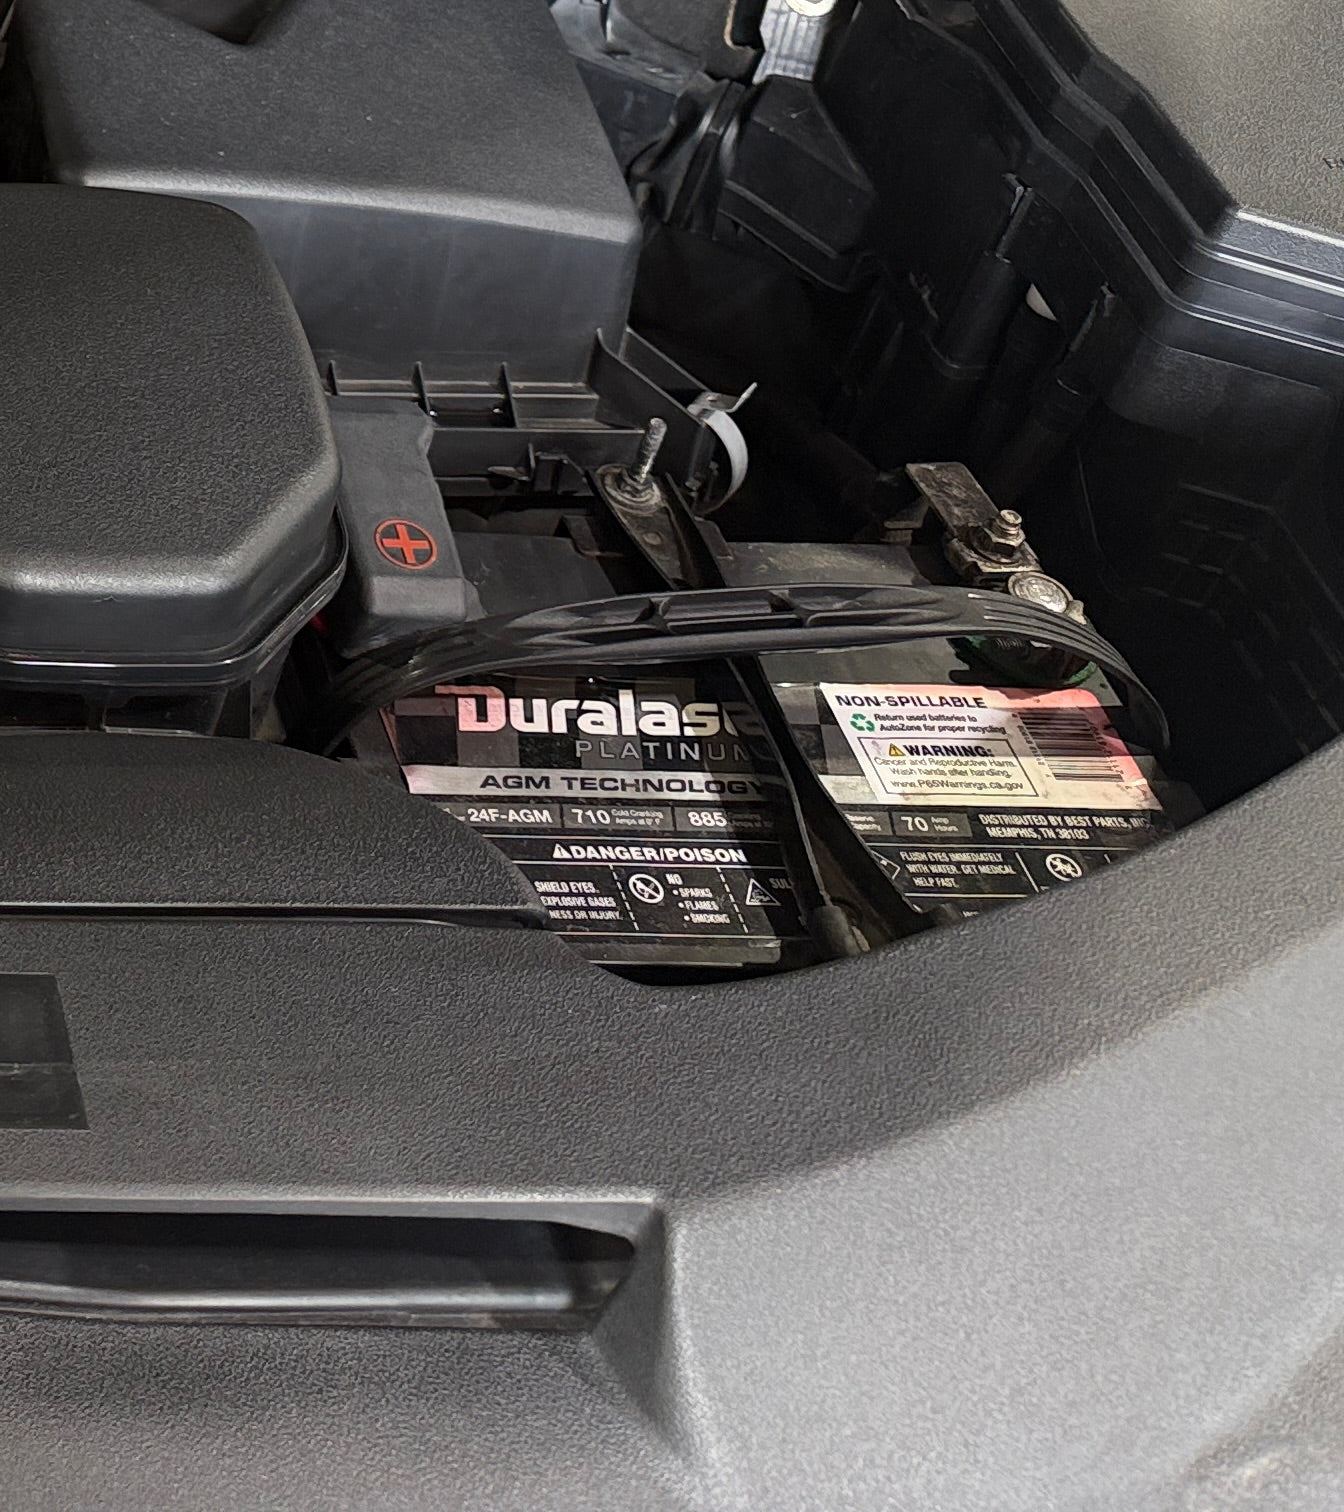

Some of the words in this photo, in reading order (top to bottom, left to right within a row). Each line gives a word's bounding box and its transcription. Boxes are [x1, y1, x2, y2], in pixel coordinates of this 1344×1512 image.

[835, 694, 988, 709] NON-SPILLABLE
[434, 684, 739, 737] Duralas
[874, 713, 904, 722] Return
[906, 713, 927, 722] used
[928, 713, 967, 723] batteries
[967, 714, 977, 723] to
[879, 723, 922, 732] AutoZone
[923, 723, 936, 732] for
[938, 725, 966, 734] proper
[904, 744, 995, 757] WARNING:
[874, 757, 907, 766] Cancer
[910, 758, 927, 766] and
[889, 767, 916, 776] Wash
[479, 775, 550, 789] AGM
[571, 808, 611, 825] 710
[688, 810, 728, 827] 885
[978, 814, 1048, 826] DISTRIBUTED
[1048, 815, 1063, 826] BY
[1064, 815, 1092, 827] BEST
[1093, 816, 1132, 828] PARTS,
[900, 816, 929, 832] 70
[986, 827, 1042, 840] MEMPHIS,
[1042, 828, 1057, 839] TN
[569, 844, 748, 863] DANGER/POISON
[900, 851, 927, 861] FLUSH
[927, 852, 949, 862] EYES
[949, 852, 1004, 863] IMMEDIATELY
[905, 863, 929, 874] WITH
[961, 865, 979, 875] GET
[979, 865, 1017, 875] MEDICAL
[665, 873, 683, 886] NO
[912, 877, 935, 887] HELP
[534, 880, 569, 893] SHIELD
[678, 887, 713, 899] SPARKS
[540, 895, 587, 907] EXPLOSIVE
[587, 896, 617, 908] GASES
[684, 900, 719, 912] FLAMES
[689, 913, 731, 924] SMOKING
